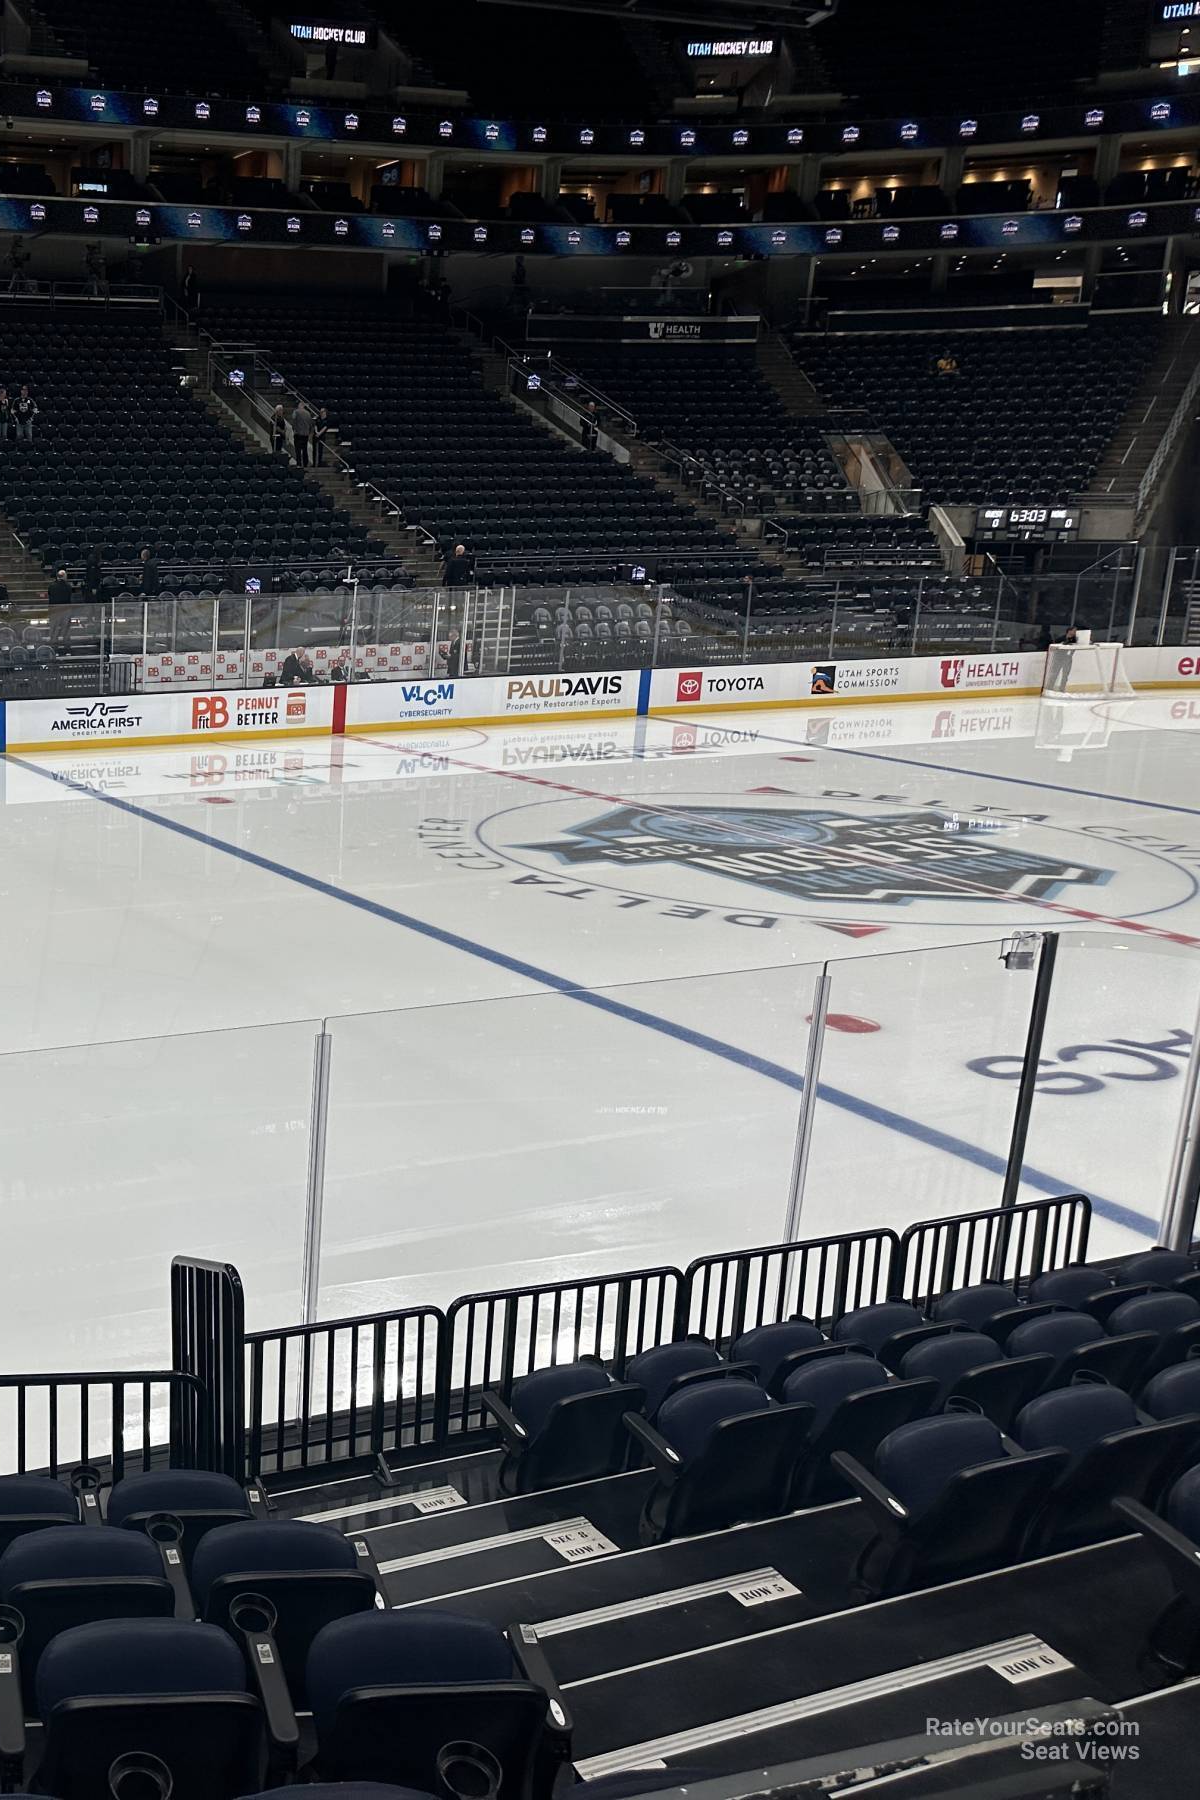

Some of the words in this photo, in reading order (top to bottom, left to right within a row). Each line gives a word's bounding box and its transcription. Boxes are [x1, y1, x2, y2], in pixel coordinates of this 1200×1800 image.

[1163, 2, 1193, 18] UTAH
[345, 30, 365, 43] CLUB
[687, 43, 711, 56] UTAH
[712, 42, 748, 55] HOCKEY
[749, 40, 773, 54] CLUB
[1010, 510, 1046, 522] 63:03
[992, 519, 999, 528] 0
[838, 669, 862, 678] UTAH
[866, 667, 899, 677] SPORTS
[967, 662, 1019, 678] HEALTH
[708, 677, 764, 693] TOYOTA
[838, 679, 898, 689] COMMISSION
[237, 697, 279, 710] PEANUT
[506, 702, 541, 710] Property
[544, 699, 588, 709] Restoration
[592, 698, 621, 708] Experts
[237, 713, 278, 725] BETTER
[400, 709, 452, 718] CYBERSECURITY
[51, 719, 104, 731] AMERICA
[108, 717, 142, 727] FIRST
[199, 715, 209, 729] fit
[821, 788, 1050, 823] DELTA
[417, 816, 506, 871] CENTER
[685, 836, 1000, 877] SEASON
[509, 873, 780, 930] DELTA
[421, 1498, 445, 1510] ROW
[447, 1496, 456, 1504] 3
[551, 1534, 576, 1545] SEC
[578, 1530, 586, 1540] 8
[566, 1546, 594, 1558] ROW
[597, 1542, 606, 1552] 4
[739, 1587, 770, 1602] ROW
[774, 1584, 784, 1593] 5
[1002, 1658, 1041, 1675] ROW
[1040, 1655, 1055, 1666] 6
